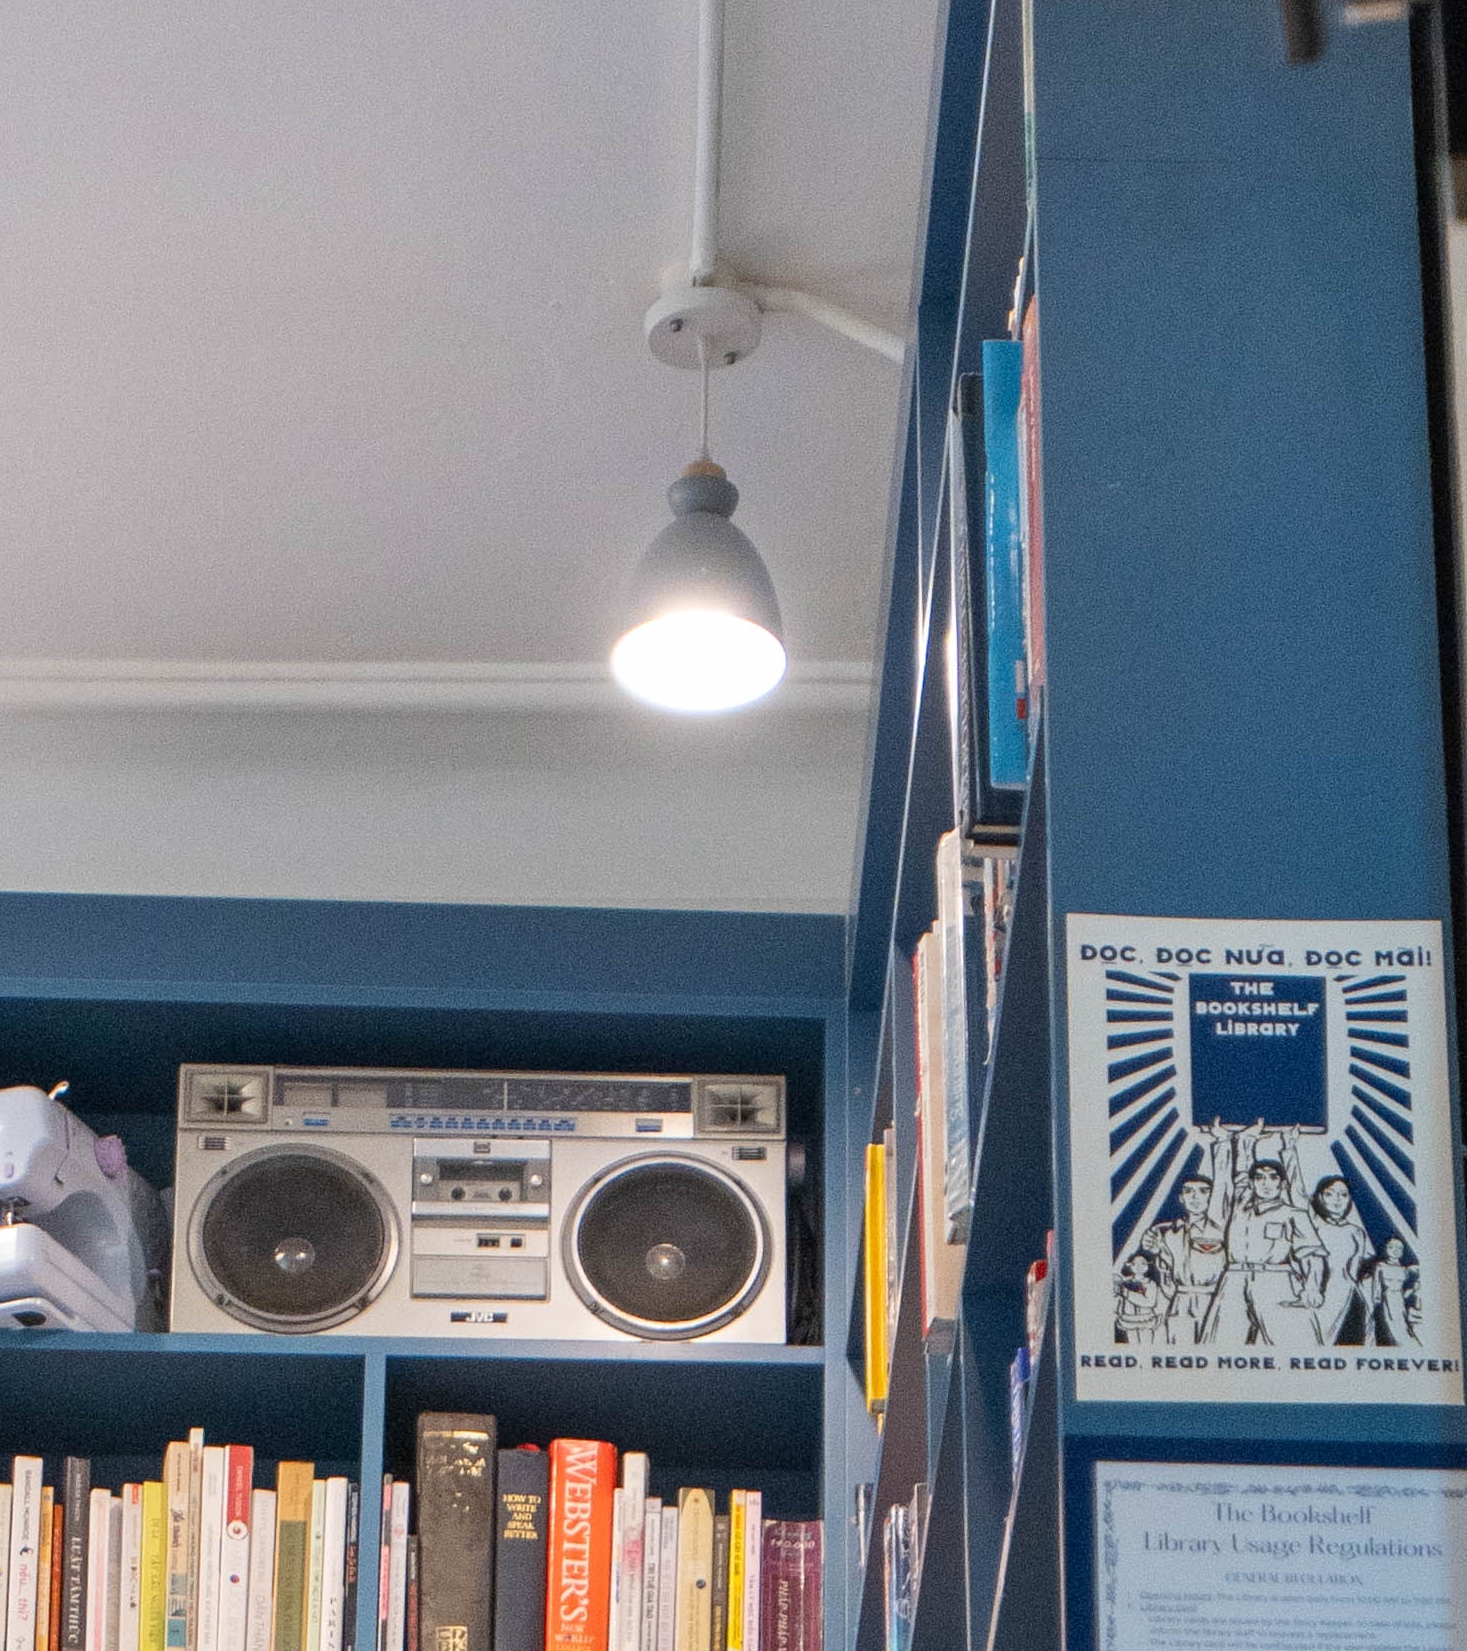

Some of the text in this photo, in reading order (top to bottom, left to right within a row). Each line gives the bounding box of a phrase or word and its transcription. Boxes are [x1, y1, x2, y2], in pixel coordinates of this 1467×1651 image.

[1231, 981, 1274, 996] THE
[1195, 1001, 1319, 1017] BOOKSHELF
[1216, 1020, 1301, 1037] LIBRARY
[465, 1312, 494, 1323] JVC
[1081, 1354, 1460, 1373] READ, READ MORE, READ FOREVER!
[503, 1493, 541, 1504] HOW TO
[506, 1504, 537, 1512] WRITE
[1215, 1502, 1375, 1525] The Bookshelf
[508, 1521, 535, 1530] SPEAK
[560, 1441, 599, 1622] WEBSTER'S
[1143, 1531, 1443, 1560] Library Usage Regulations
[561, 1623, 585, 1632] NEW
